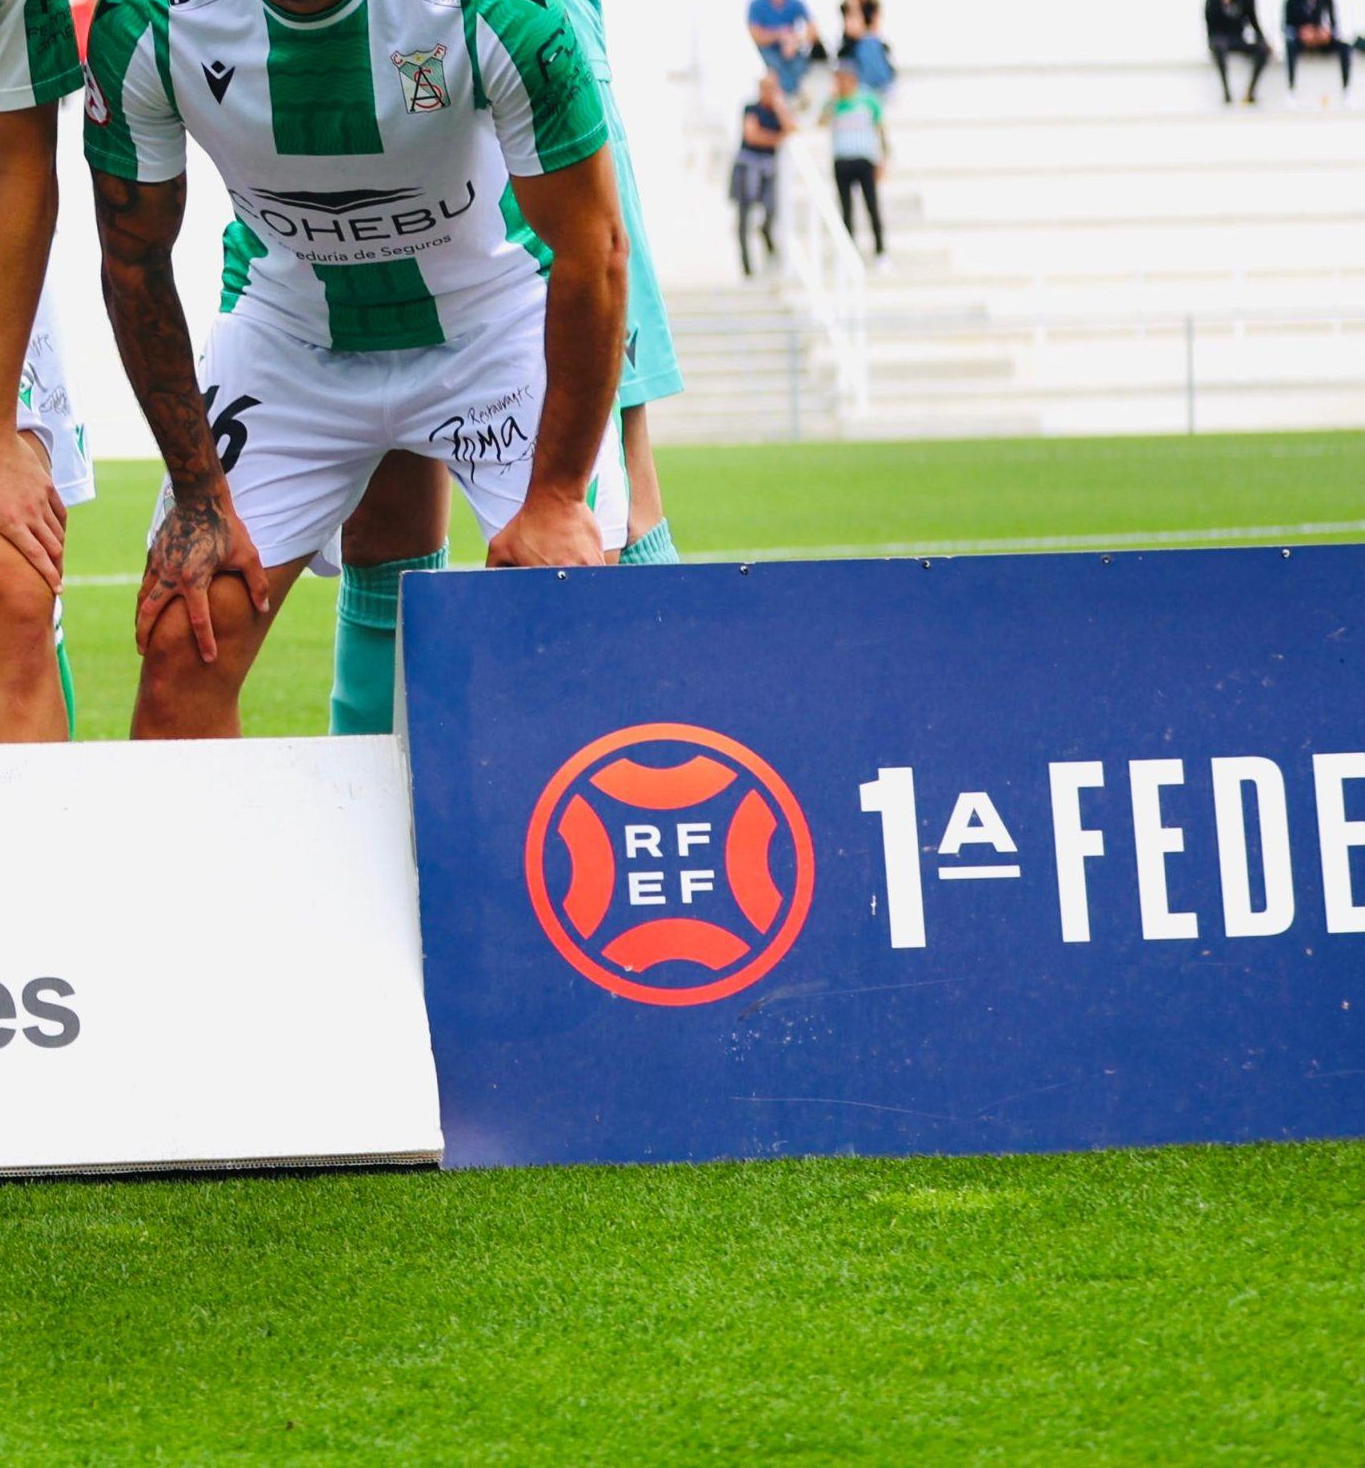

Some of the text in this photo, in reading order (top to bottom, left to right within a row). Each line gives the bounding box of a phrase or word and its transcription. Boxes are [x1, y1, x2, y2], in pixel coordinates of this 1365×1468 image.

[228, 180, 476, 243] COHEBU
[354, 249, 377, 261] de
[381, 234, 452, 258] Seguros
[624, 822, 712, 859] RF
[627, 869, 715, 906] EF
